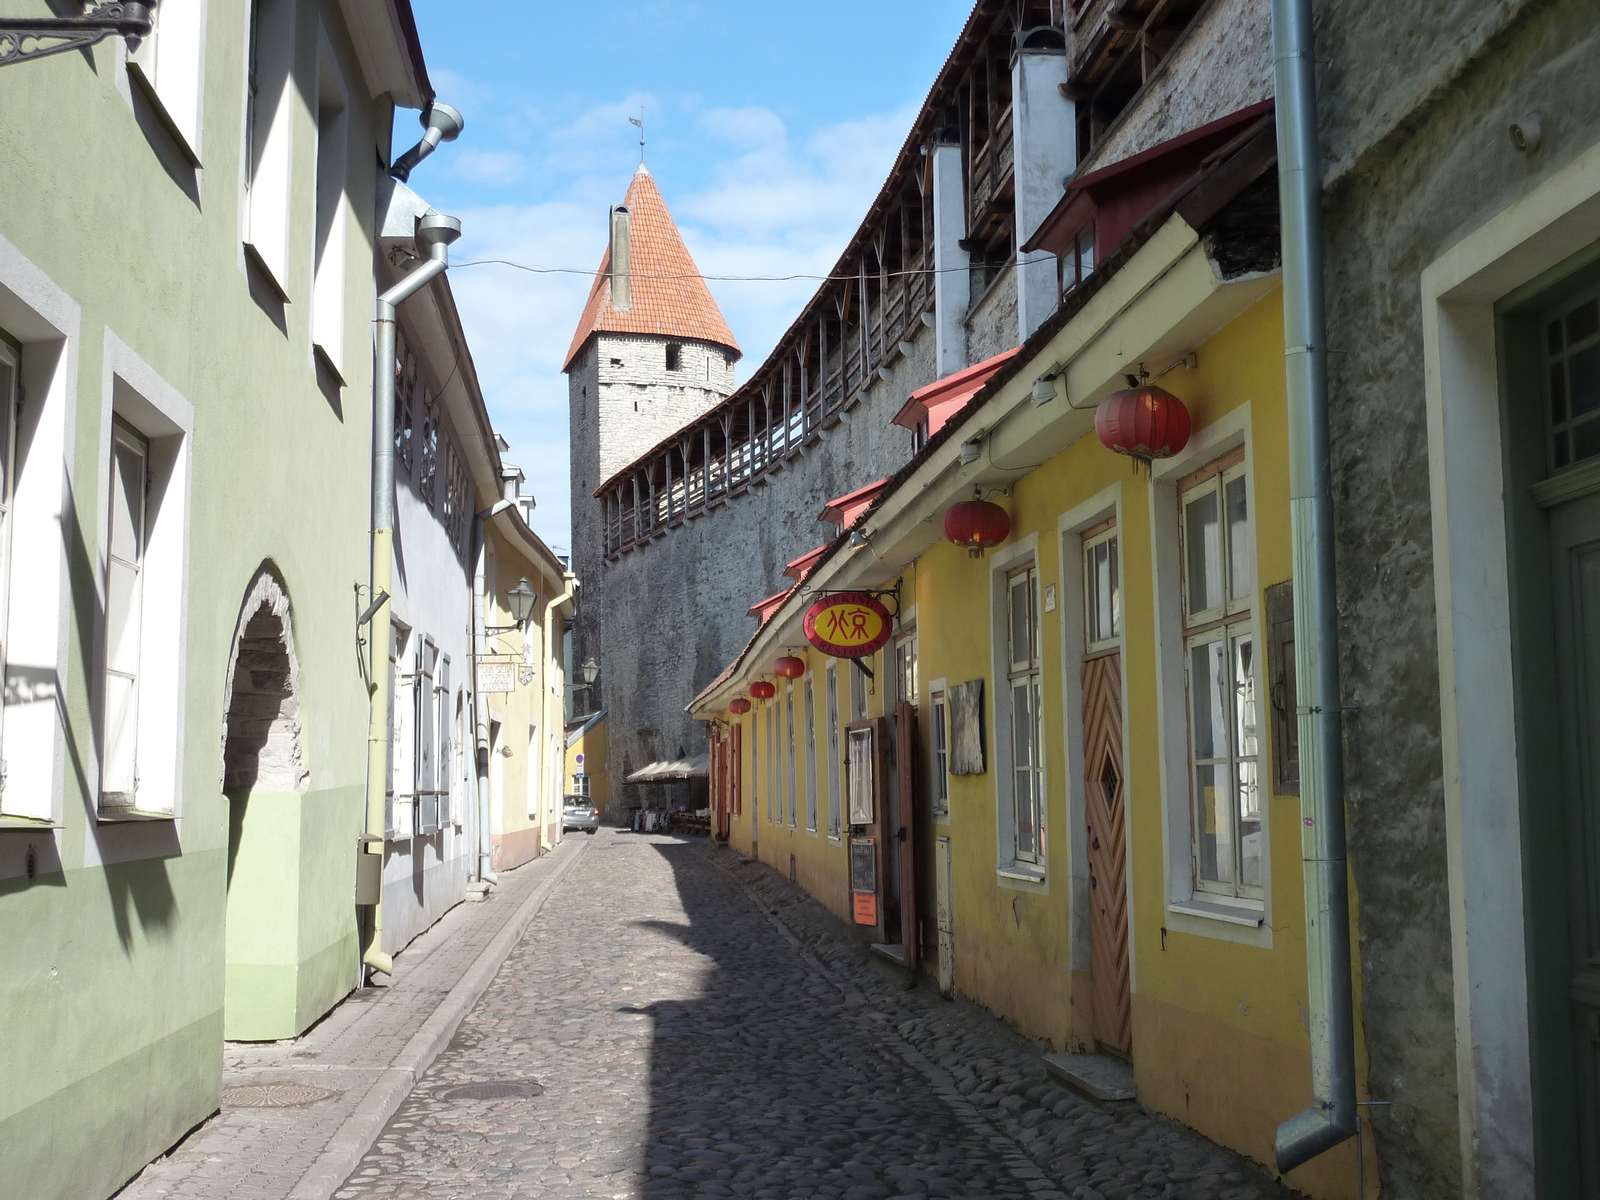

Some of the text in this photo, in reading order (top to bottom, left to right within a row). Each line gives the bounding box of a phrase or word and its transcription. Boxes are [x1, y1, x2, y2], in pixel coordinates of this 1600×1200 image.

[825, 595, 875, 609] PEKING
[818, 639, 882, 656] RESTORAN
[482, 682, 510, 691] KLOOSTER
